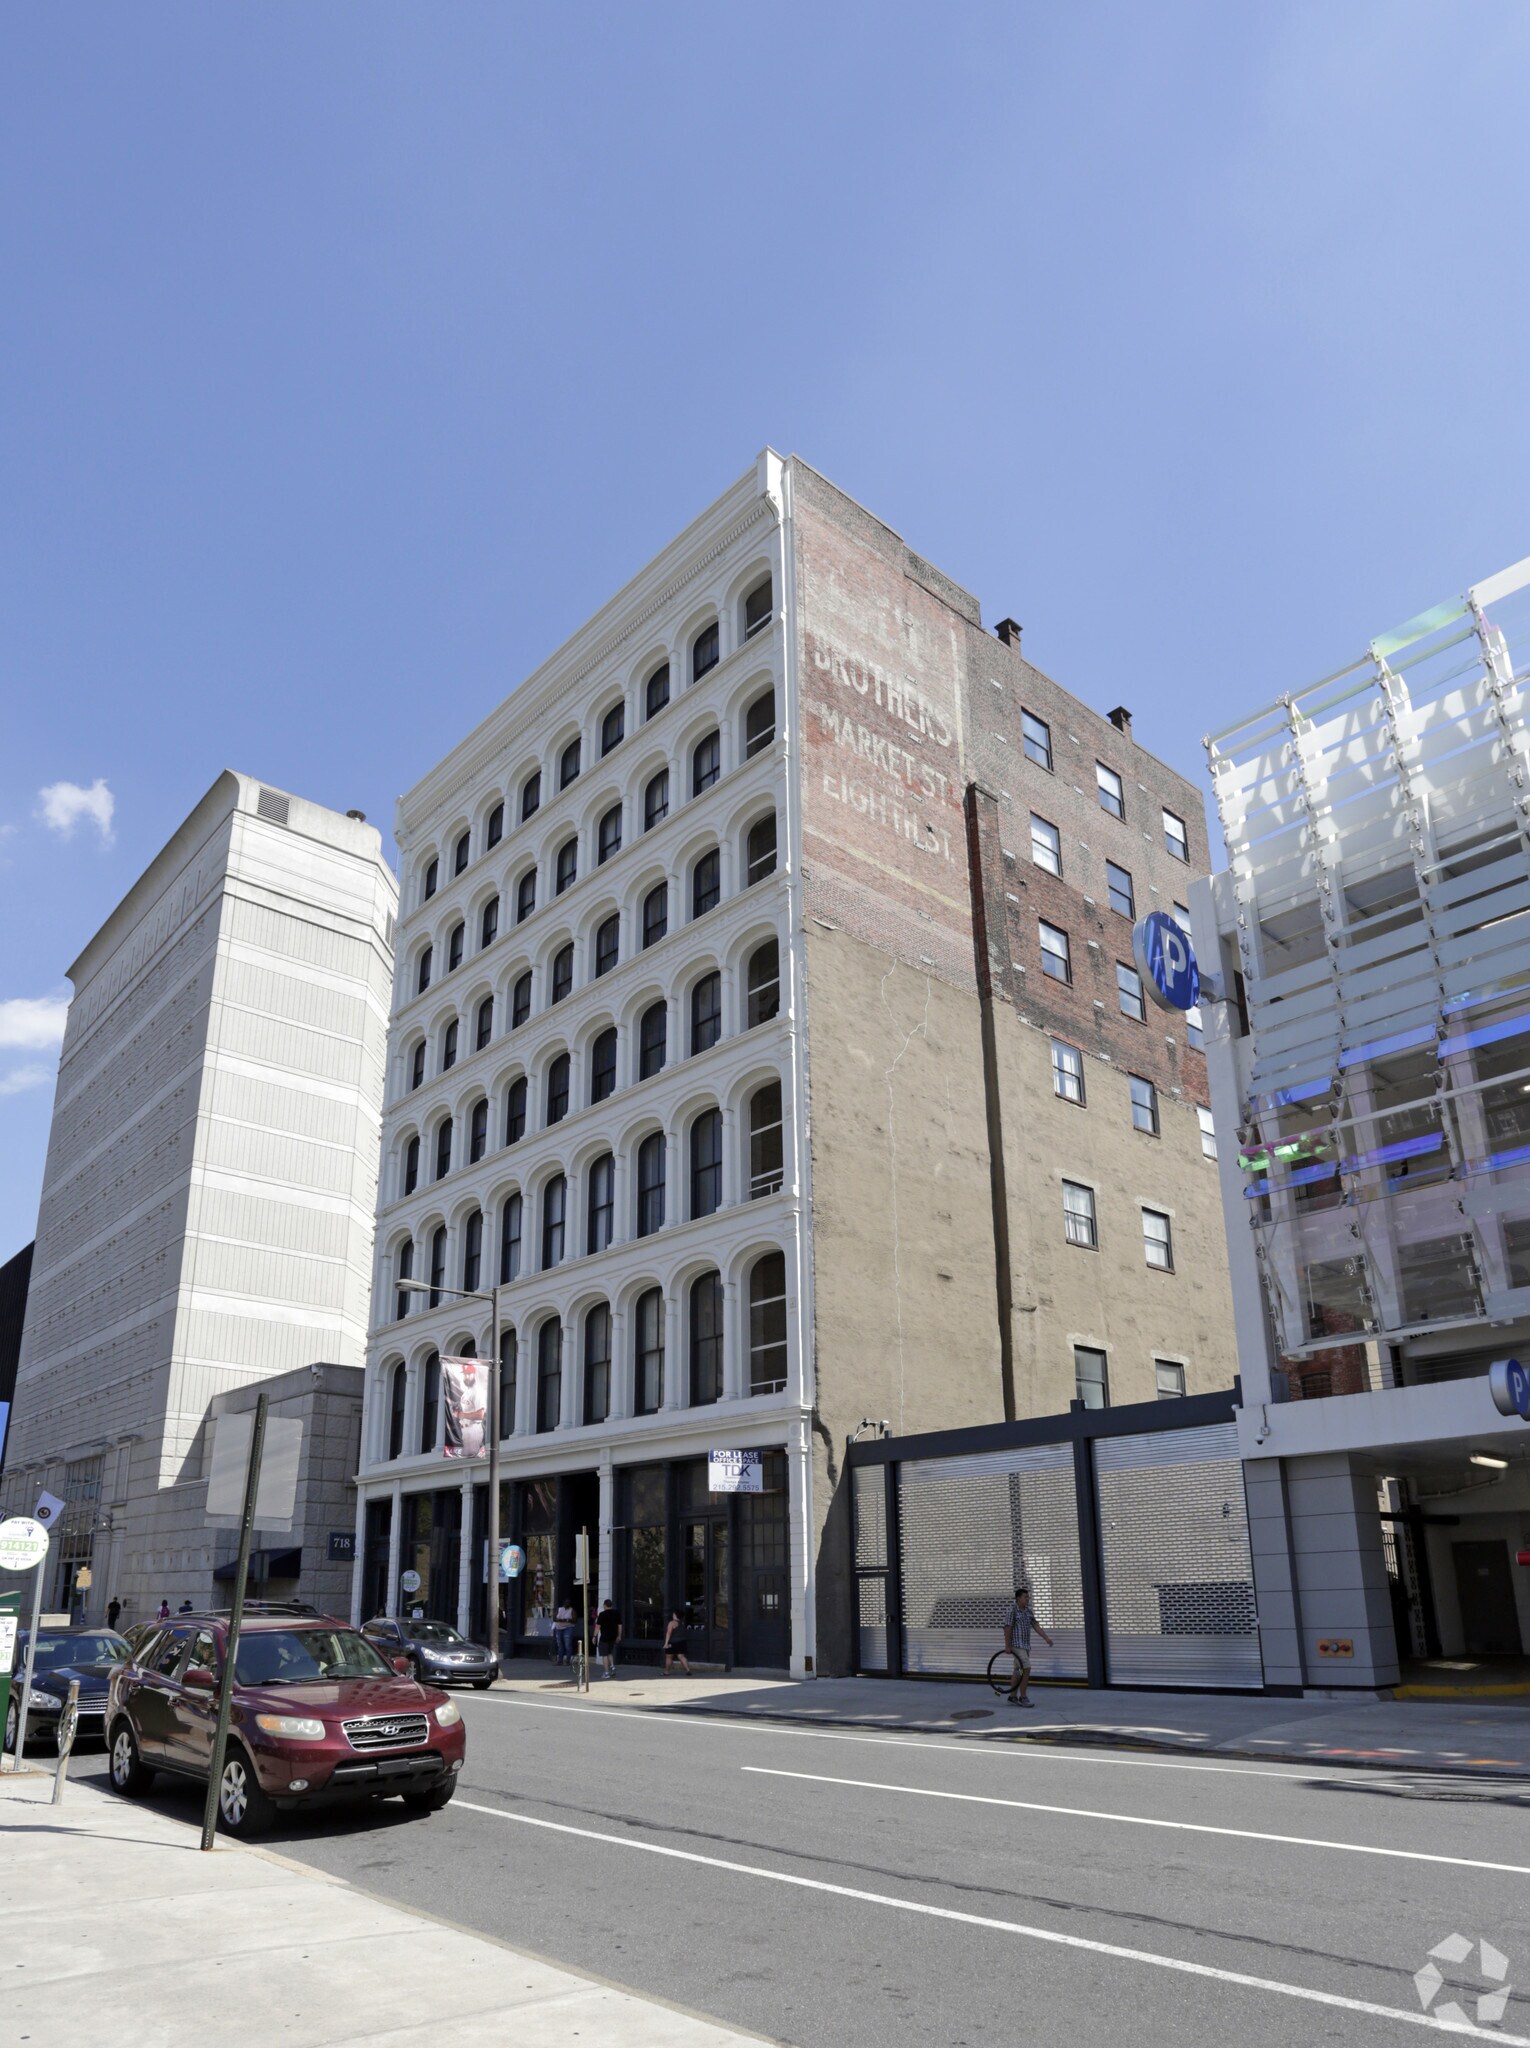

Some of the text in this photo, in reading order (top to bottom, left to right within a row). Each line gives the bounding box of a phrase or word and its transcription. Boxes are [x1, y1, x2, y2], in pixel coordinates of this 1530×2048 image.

[813, 644, 952, 748] BROTHERS
[820, 702, 916, 786] MARKET
[823, 773, 919, 842] EIGHTH
[1160, 926, 1187, 989] P
[1512, 1371, 1523, 1403] P
[713, 1450, 759, 1459] FOR LEASE
[722, 1464, 751, 1477] TDK
[0, 1541, 38, 1552] 914121
[333, 1537, 351, 1549] 718
